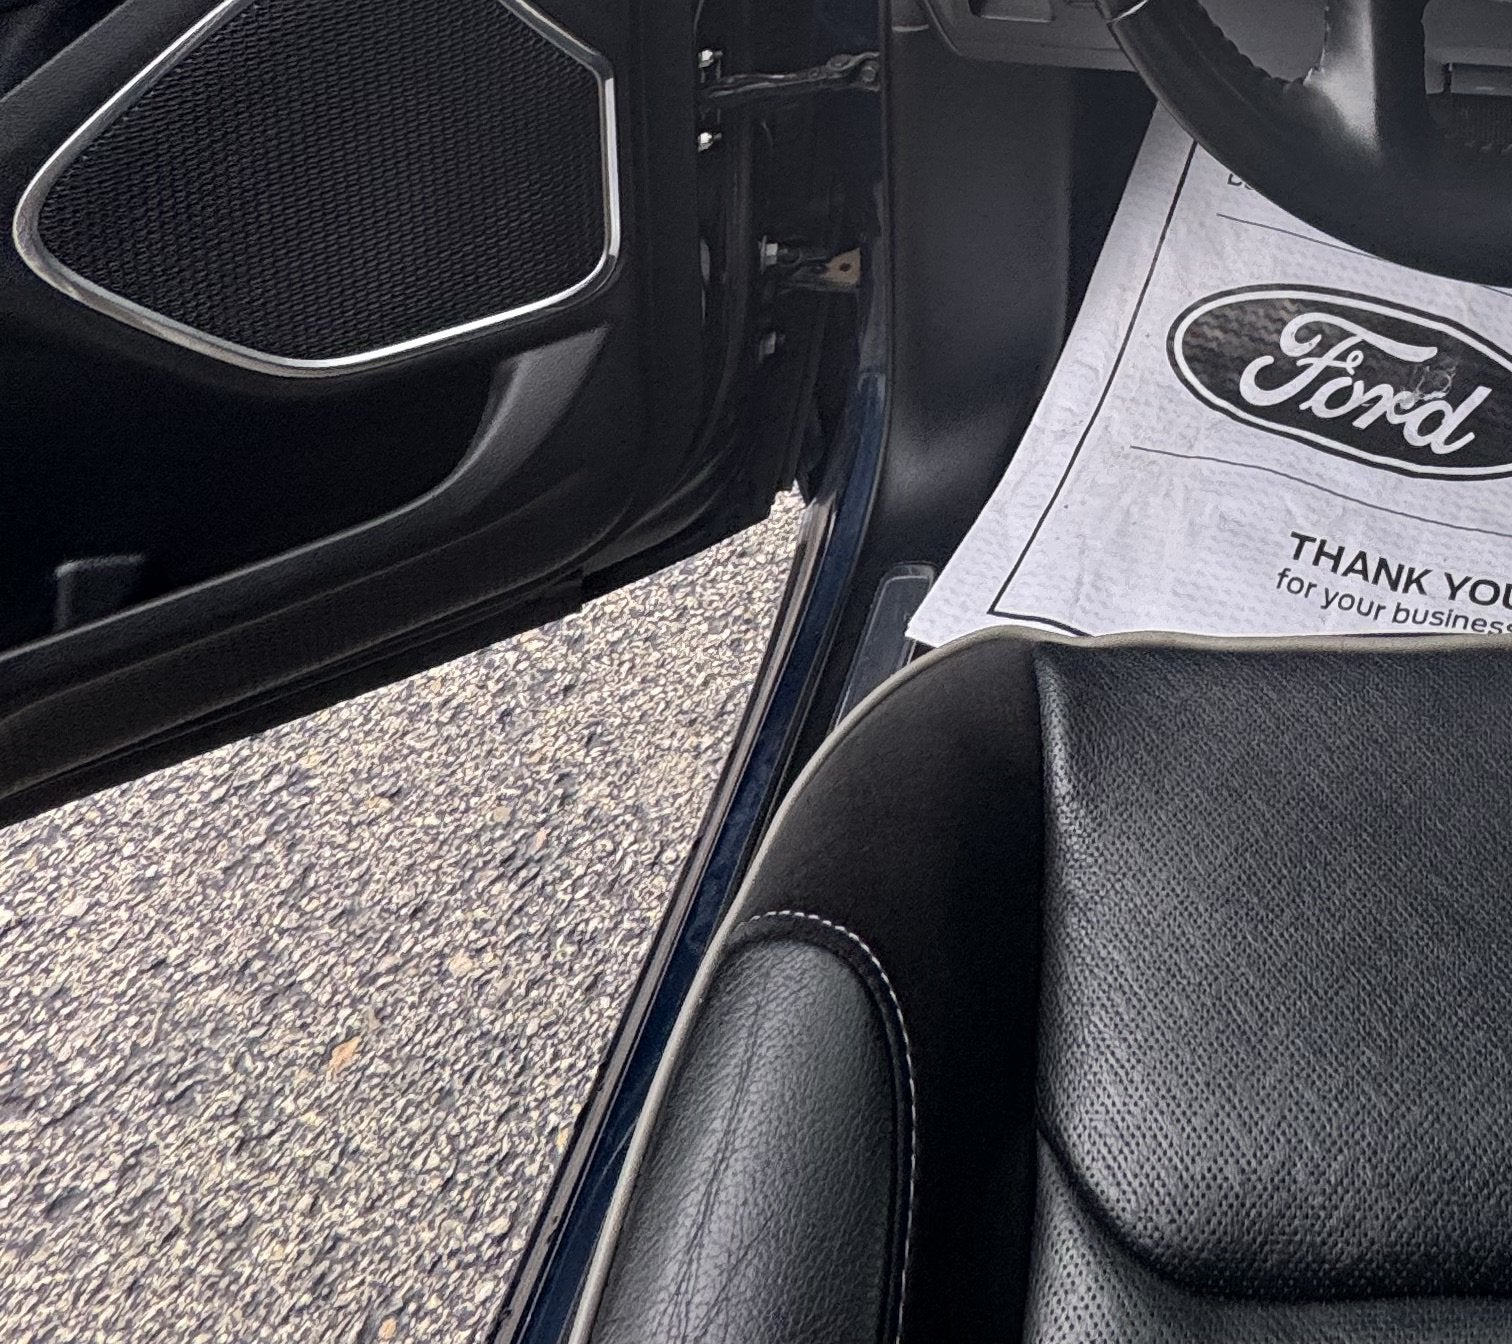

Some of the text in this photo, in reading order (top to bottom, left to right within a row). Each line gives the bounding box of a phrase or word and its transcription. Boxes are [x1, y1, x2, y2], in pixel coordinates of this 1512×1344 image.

[1240, 312, 1493, 455] Ford
[1276, 568, 1318, 599] for
[1320, 587, 1387, 622] your
[1290, 531, 1434, 596] THANK
